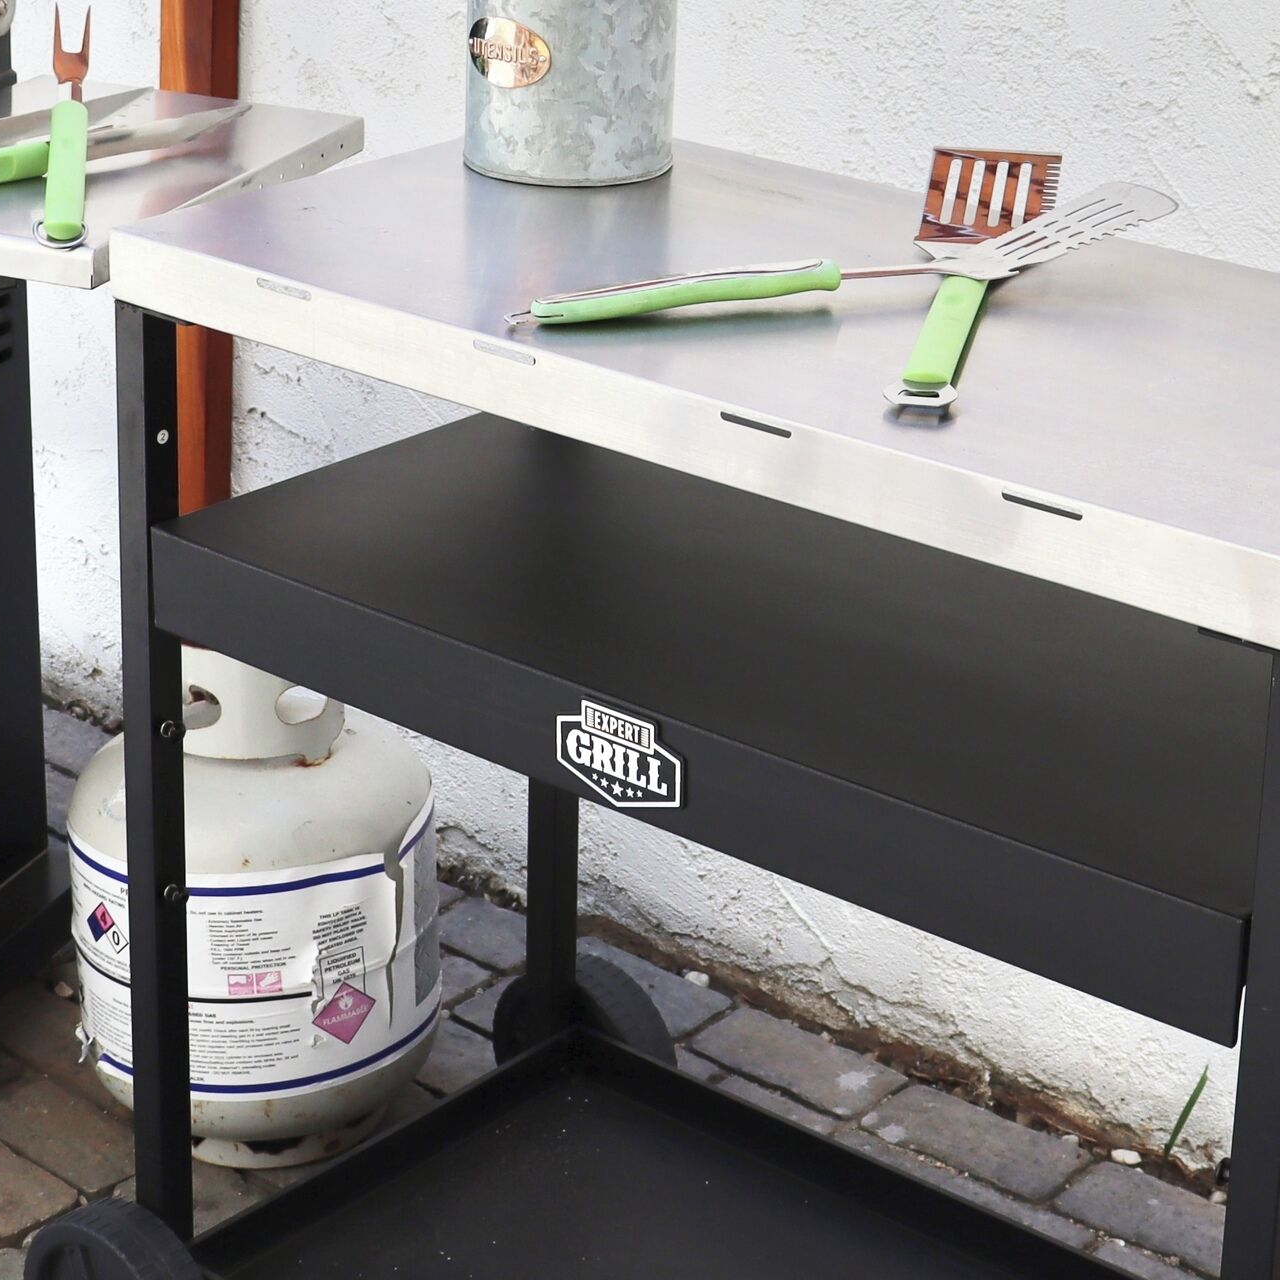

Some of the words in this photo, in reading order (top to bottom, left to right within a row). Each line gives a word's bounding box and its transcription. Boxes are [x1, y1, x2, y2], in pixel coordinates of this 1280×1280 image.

[472, 36, 539, 66] UTENSILS
[594, 711, 641, 744] EXPERT
[565, 728, 668, 797] GRILL
[112, 930, 120, 946] 0
[324, 958, 361, 973] PETROLEUM
[337, 968, 350, 976] GAS
